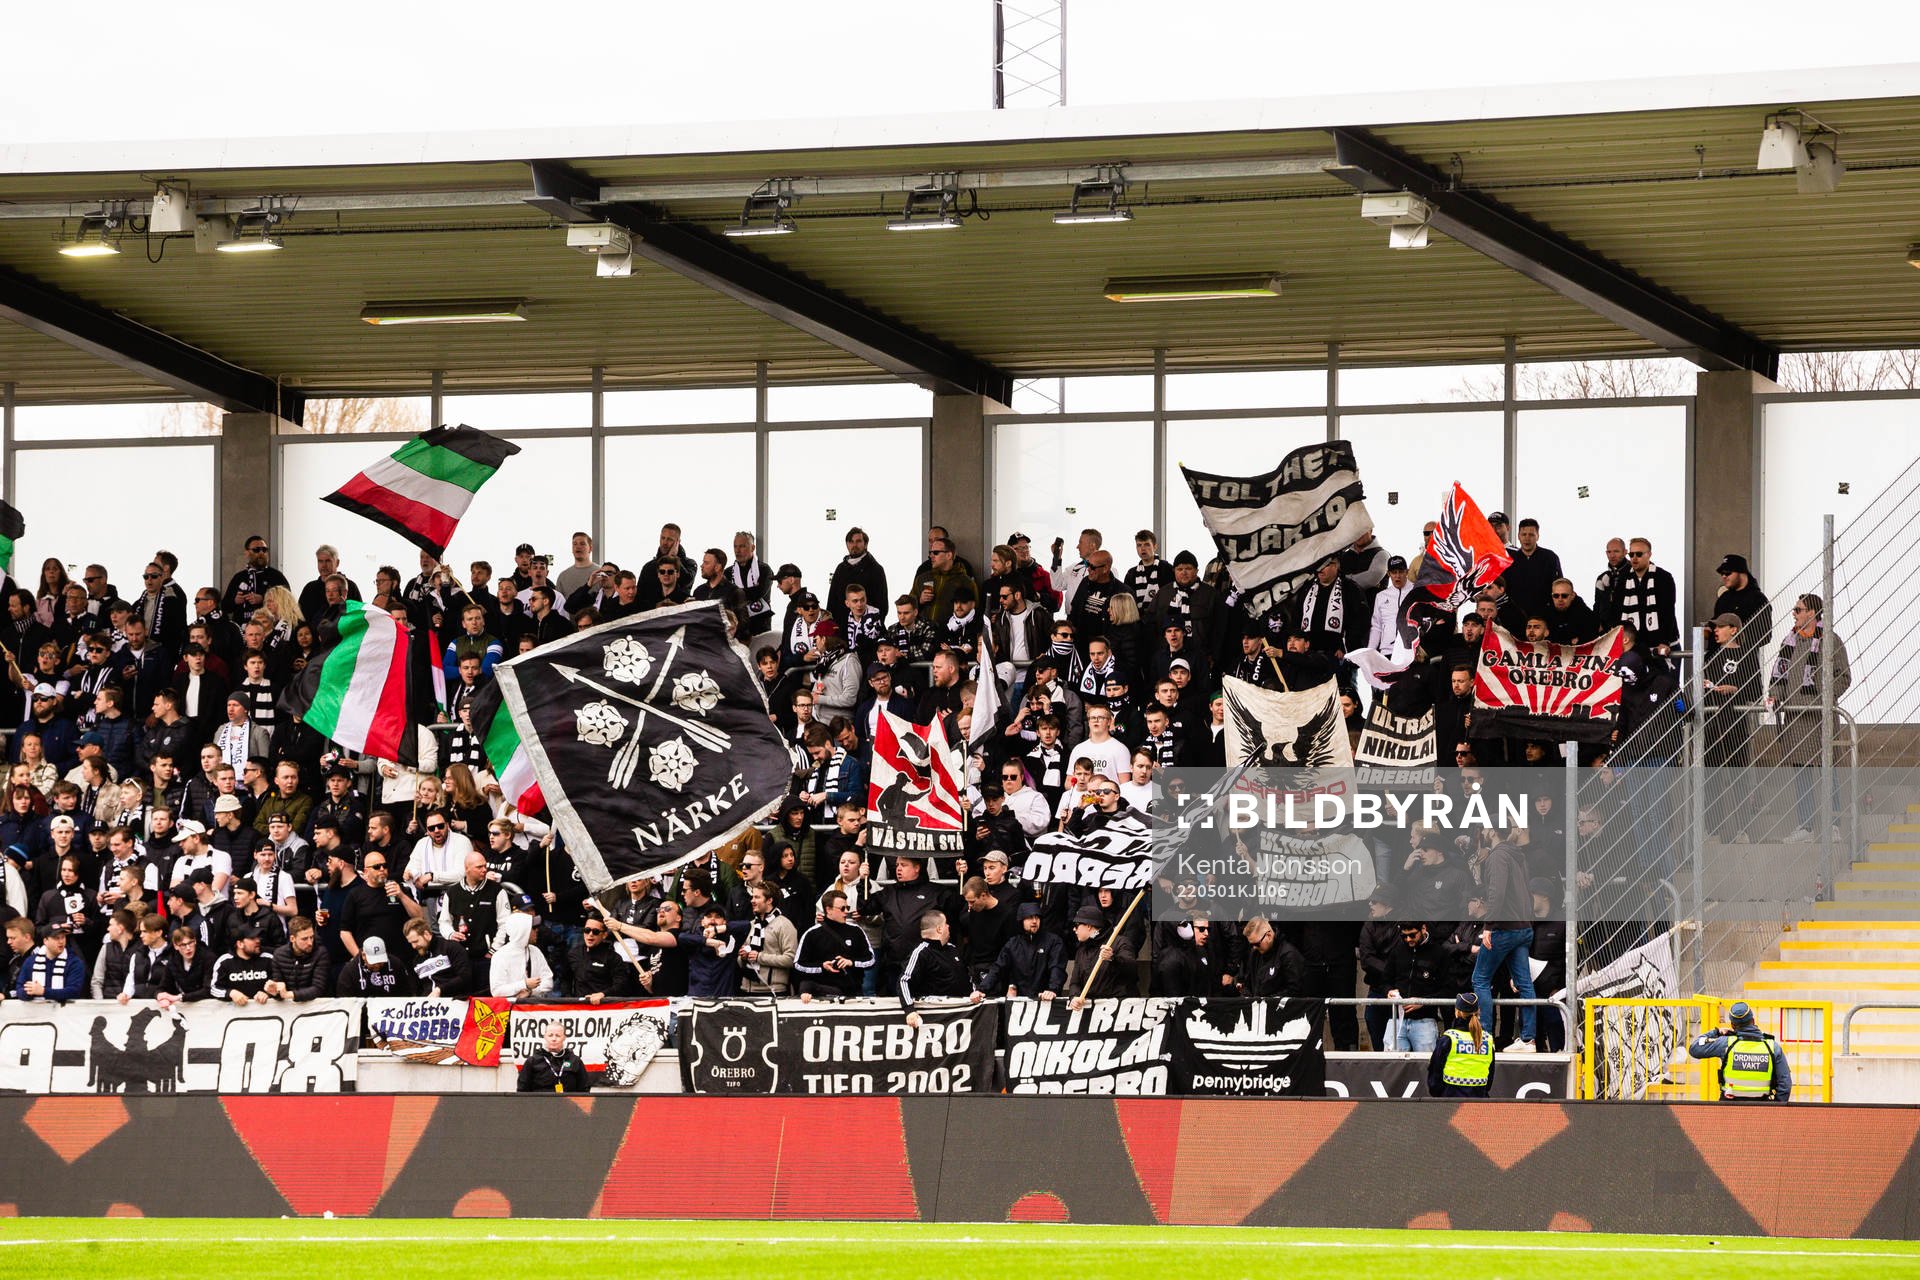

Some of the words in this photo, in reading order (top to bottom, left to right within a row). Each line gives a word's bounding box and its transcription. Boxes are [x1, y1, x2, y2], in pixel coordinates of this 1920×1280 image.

[1483, 650, 1563, 669] GAMLA
[1568, 655, 1622, 677] FINA
[1509, 666, 1592, 690] ÖREBRO
[1372, 705, 1434, 735] ULTRAS
[1363, 736, 1434, 760] NIKOLAI
[1357, 764, 1434, 784] ÖREBRO
[632, 773, 749, 851] NÄRKE
[872, 826, 935, 851] VÄSTRA
[229, 970, 267, 981] adidas
[514, 1017, 612, 1038] KROBLOM
[1008, 1000, 1170, 1036] ULTRAS
[803, 1019, 972, 1063] ÖREBRO
[1008, 1023, 1167, 1078] NIKOLAI
[1458, 1044, 1487, 1055] POLS
[1733, 1054, 1769, 1063] ORDNINGS
[1742, 1062, 1760, 1070] VAKT
[711, 1065, 755, 1078] ÖREBRO
[887, 1064, 972, 1094] 2002
[1192, 1074, 1291, 1092] pennybridge
